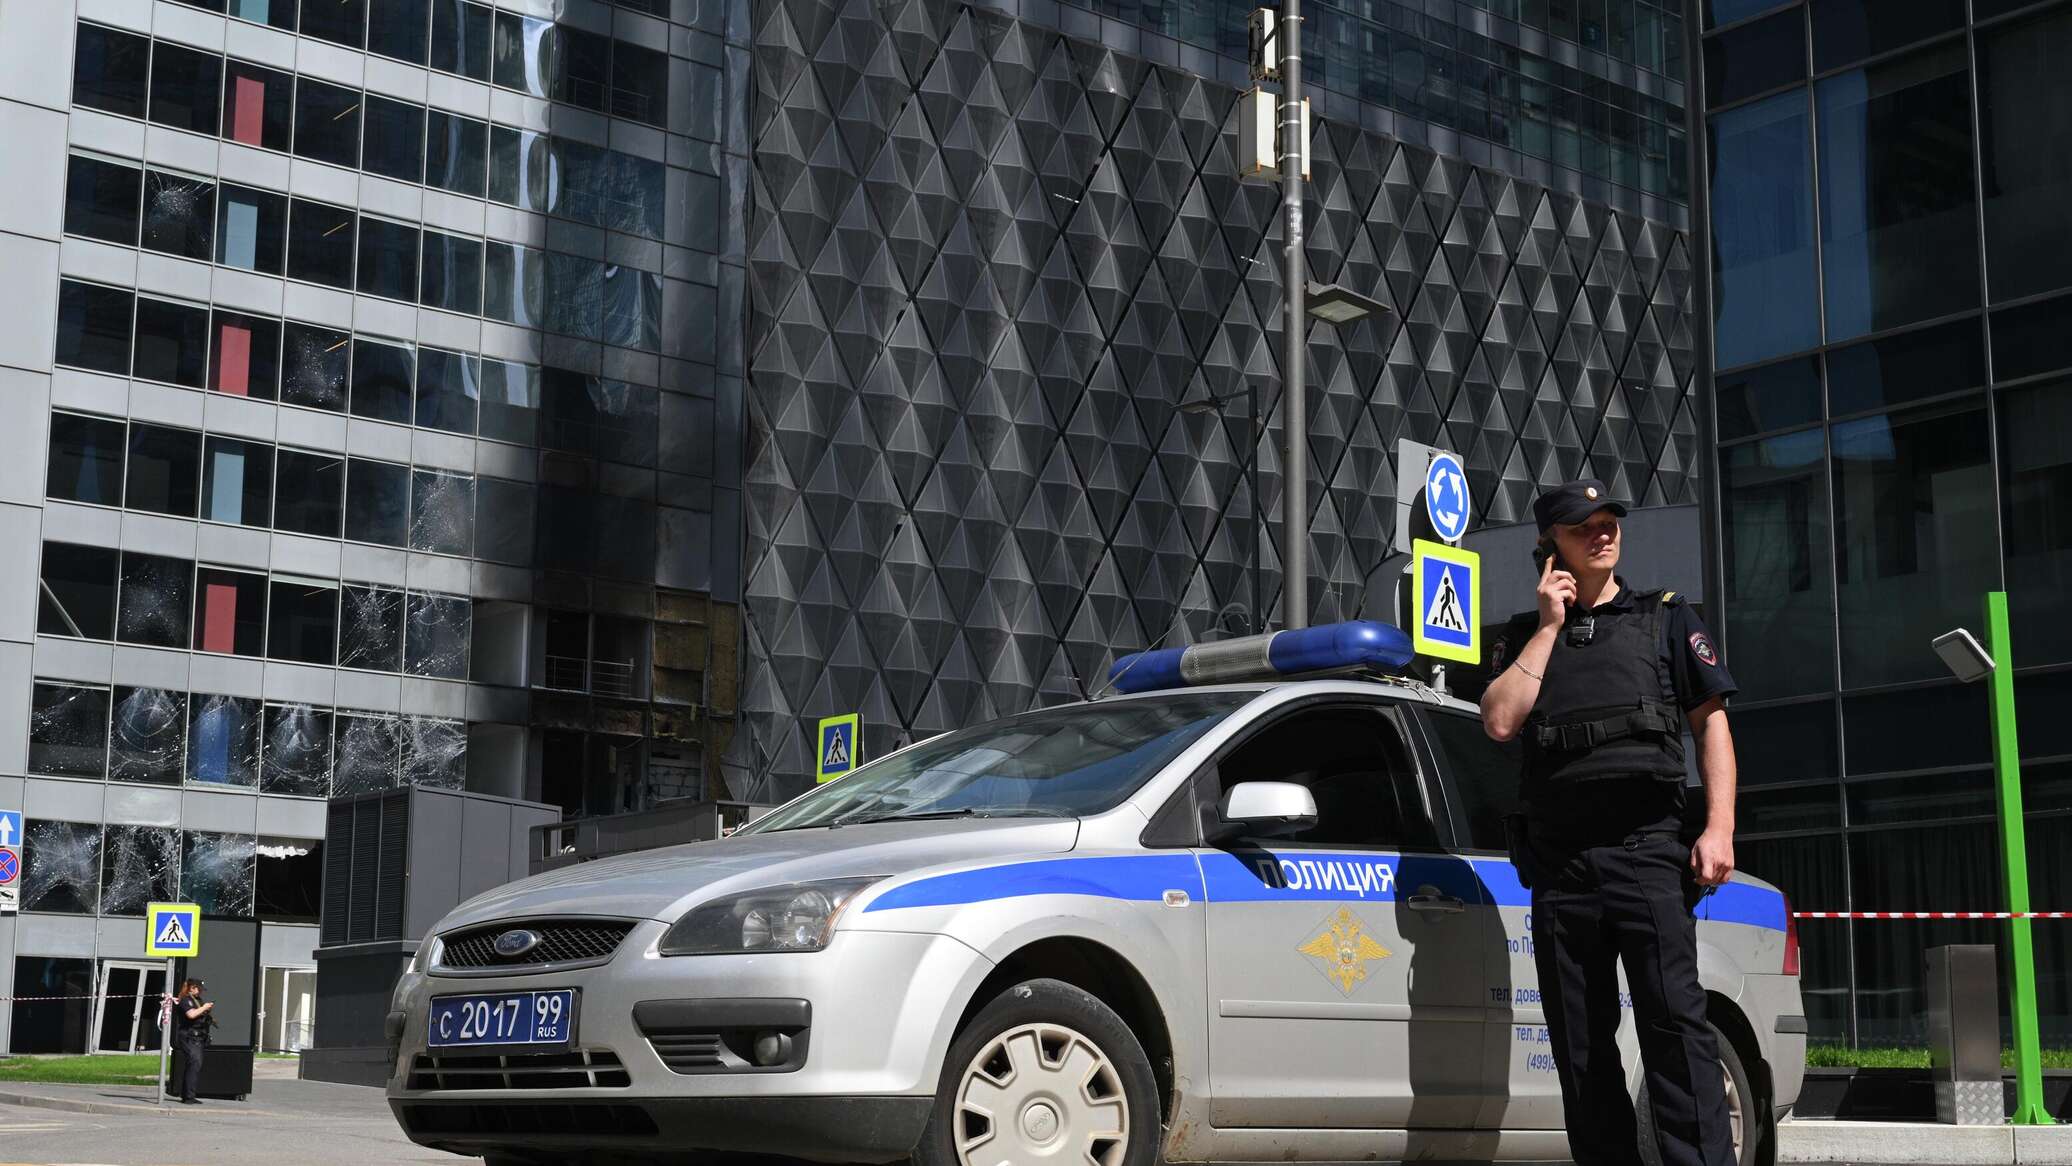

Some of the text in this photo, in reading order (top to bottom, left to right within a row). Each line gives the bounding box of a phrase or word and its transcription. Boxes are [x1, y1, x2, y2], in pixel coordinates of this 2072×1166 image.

[1256, 859, 1398, 898] ПОЛИЦИЯ
[1490, 986, 1512, 1001] тел.
[1515, 988, 1542, 1005] дове
[459, 999, 520, 1039] 2017
[536, 995, 562, 1025] 99
[537, 1026, 558, 1038] RUS
[1516, 1026, 1550, 1045] тел. де
[1526, 1051, 1557, 1073] (499)2
